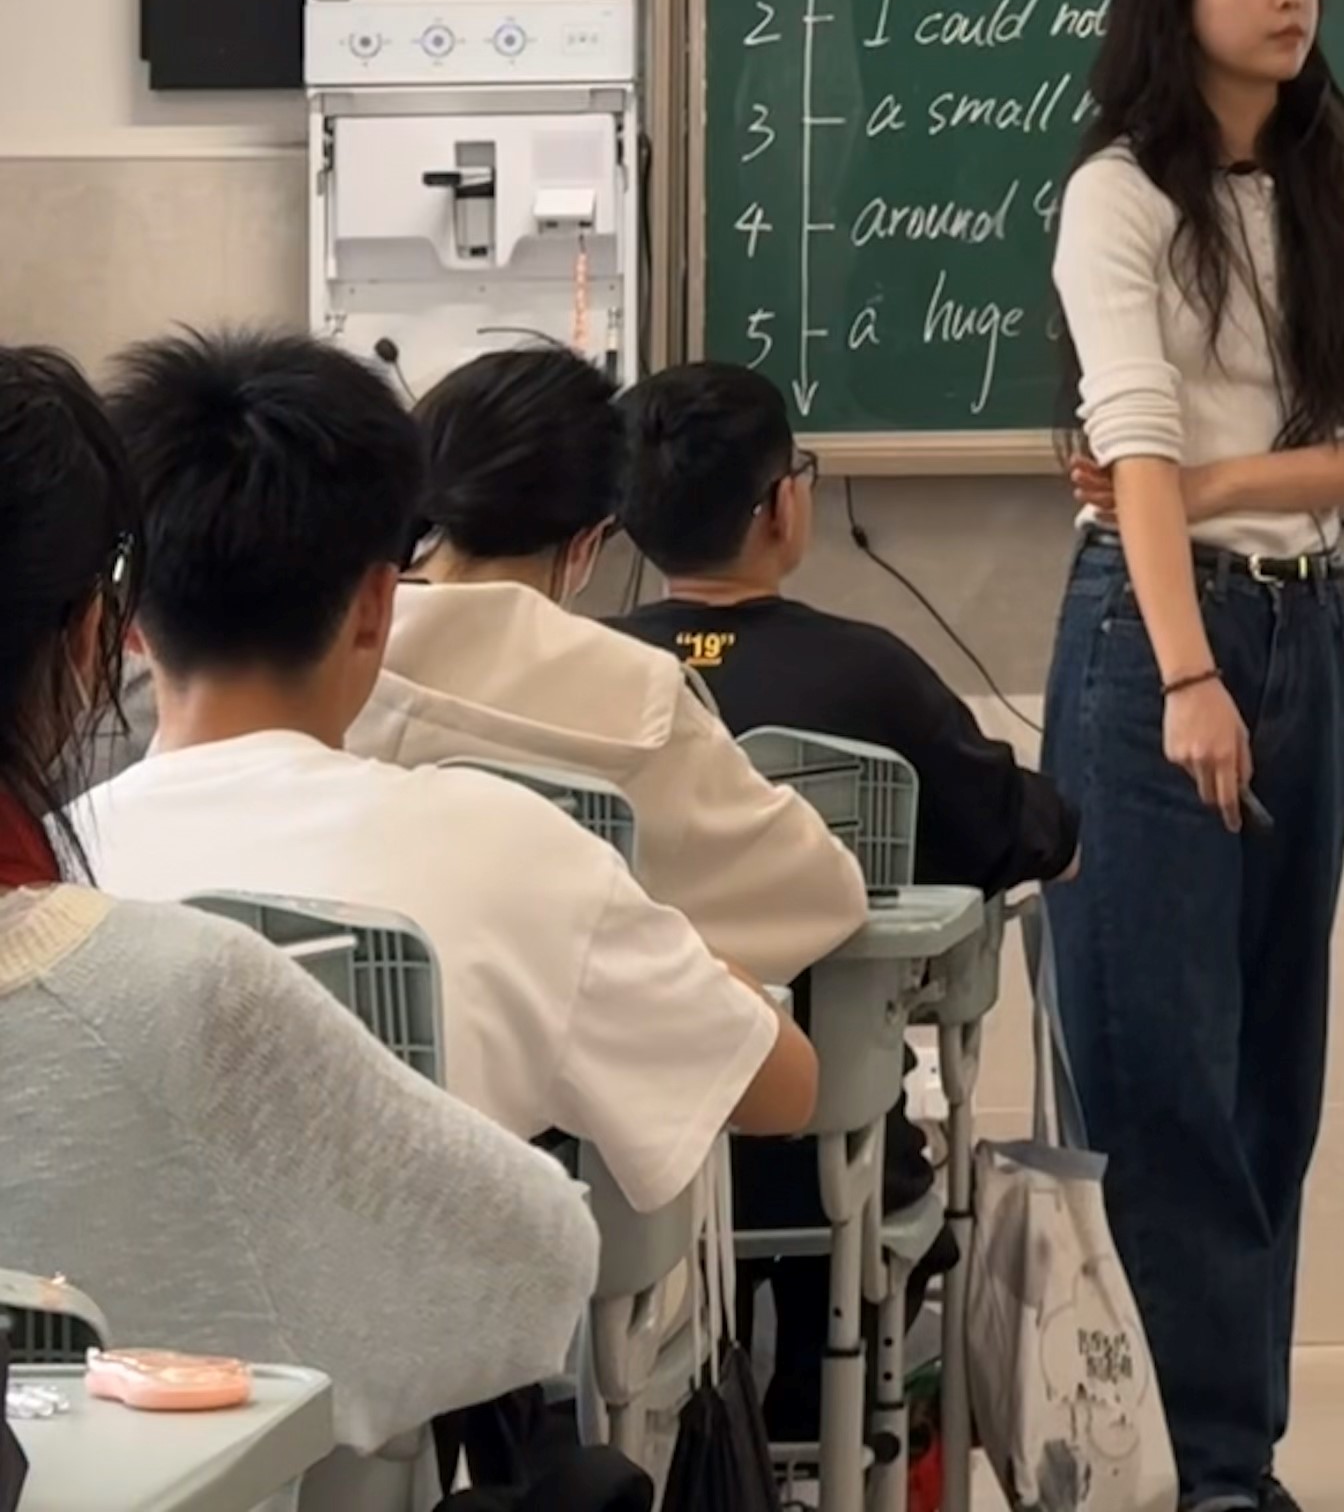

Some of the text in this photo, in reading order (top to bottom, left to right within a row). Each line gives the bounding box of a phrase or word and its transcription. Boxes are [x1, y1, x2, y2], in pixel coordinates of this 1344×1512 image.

[742, 2, 783, 46] 2
[740, 104, 776, 162] 3
[865, 91, 908, 138] a
[927, 71, 1070, 137] small
[733, 202, 773, 258] 4
[850, 178, 1019, 247] around
[744, 307, 776, 369] 5
[923, 269, 1024, 414] huge
